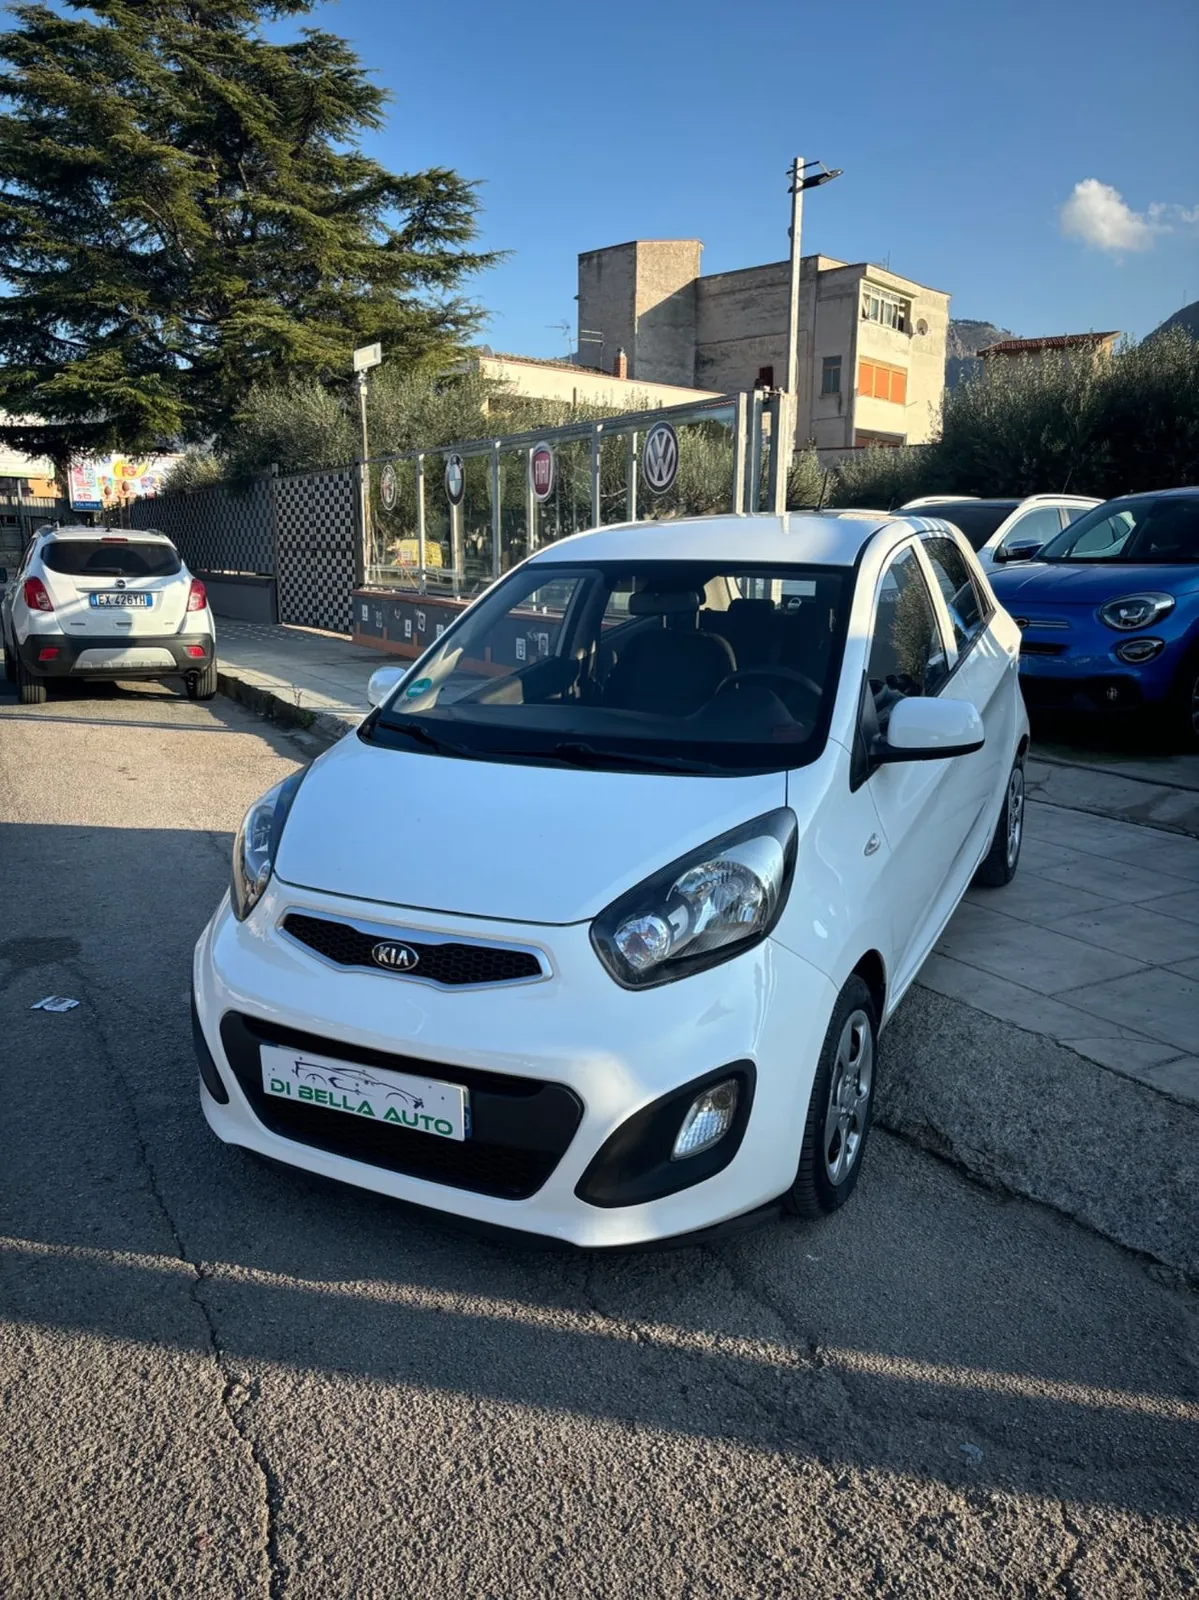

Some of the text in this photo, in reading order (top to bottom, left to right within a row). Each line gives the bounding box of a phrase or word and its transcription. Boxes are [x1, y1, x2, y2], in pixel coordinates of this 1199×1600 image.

[98, 594, 146, 605] EX 426YH
[378, 946, 409, 966] KIA
[270, 1077, 292, 1096] DI
[298, 1085, 376, 1117] BELLA
[383, 1107, 454, 1136] AUTO
